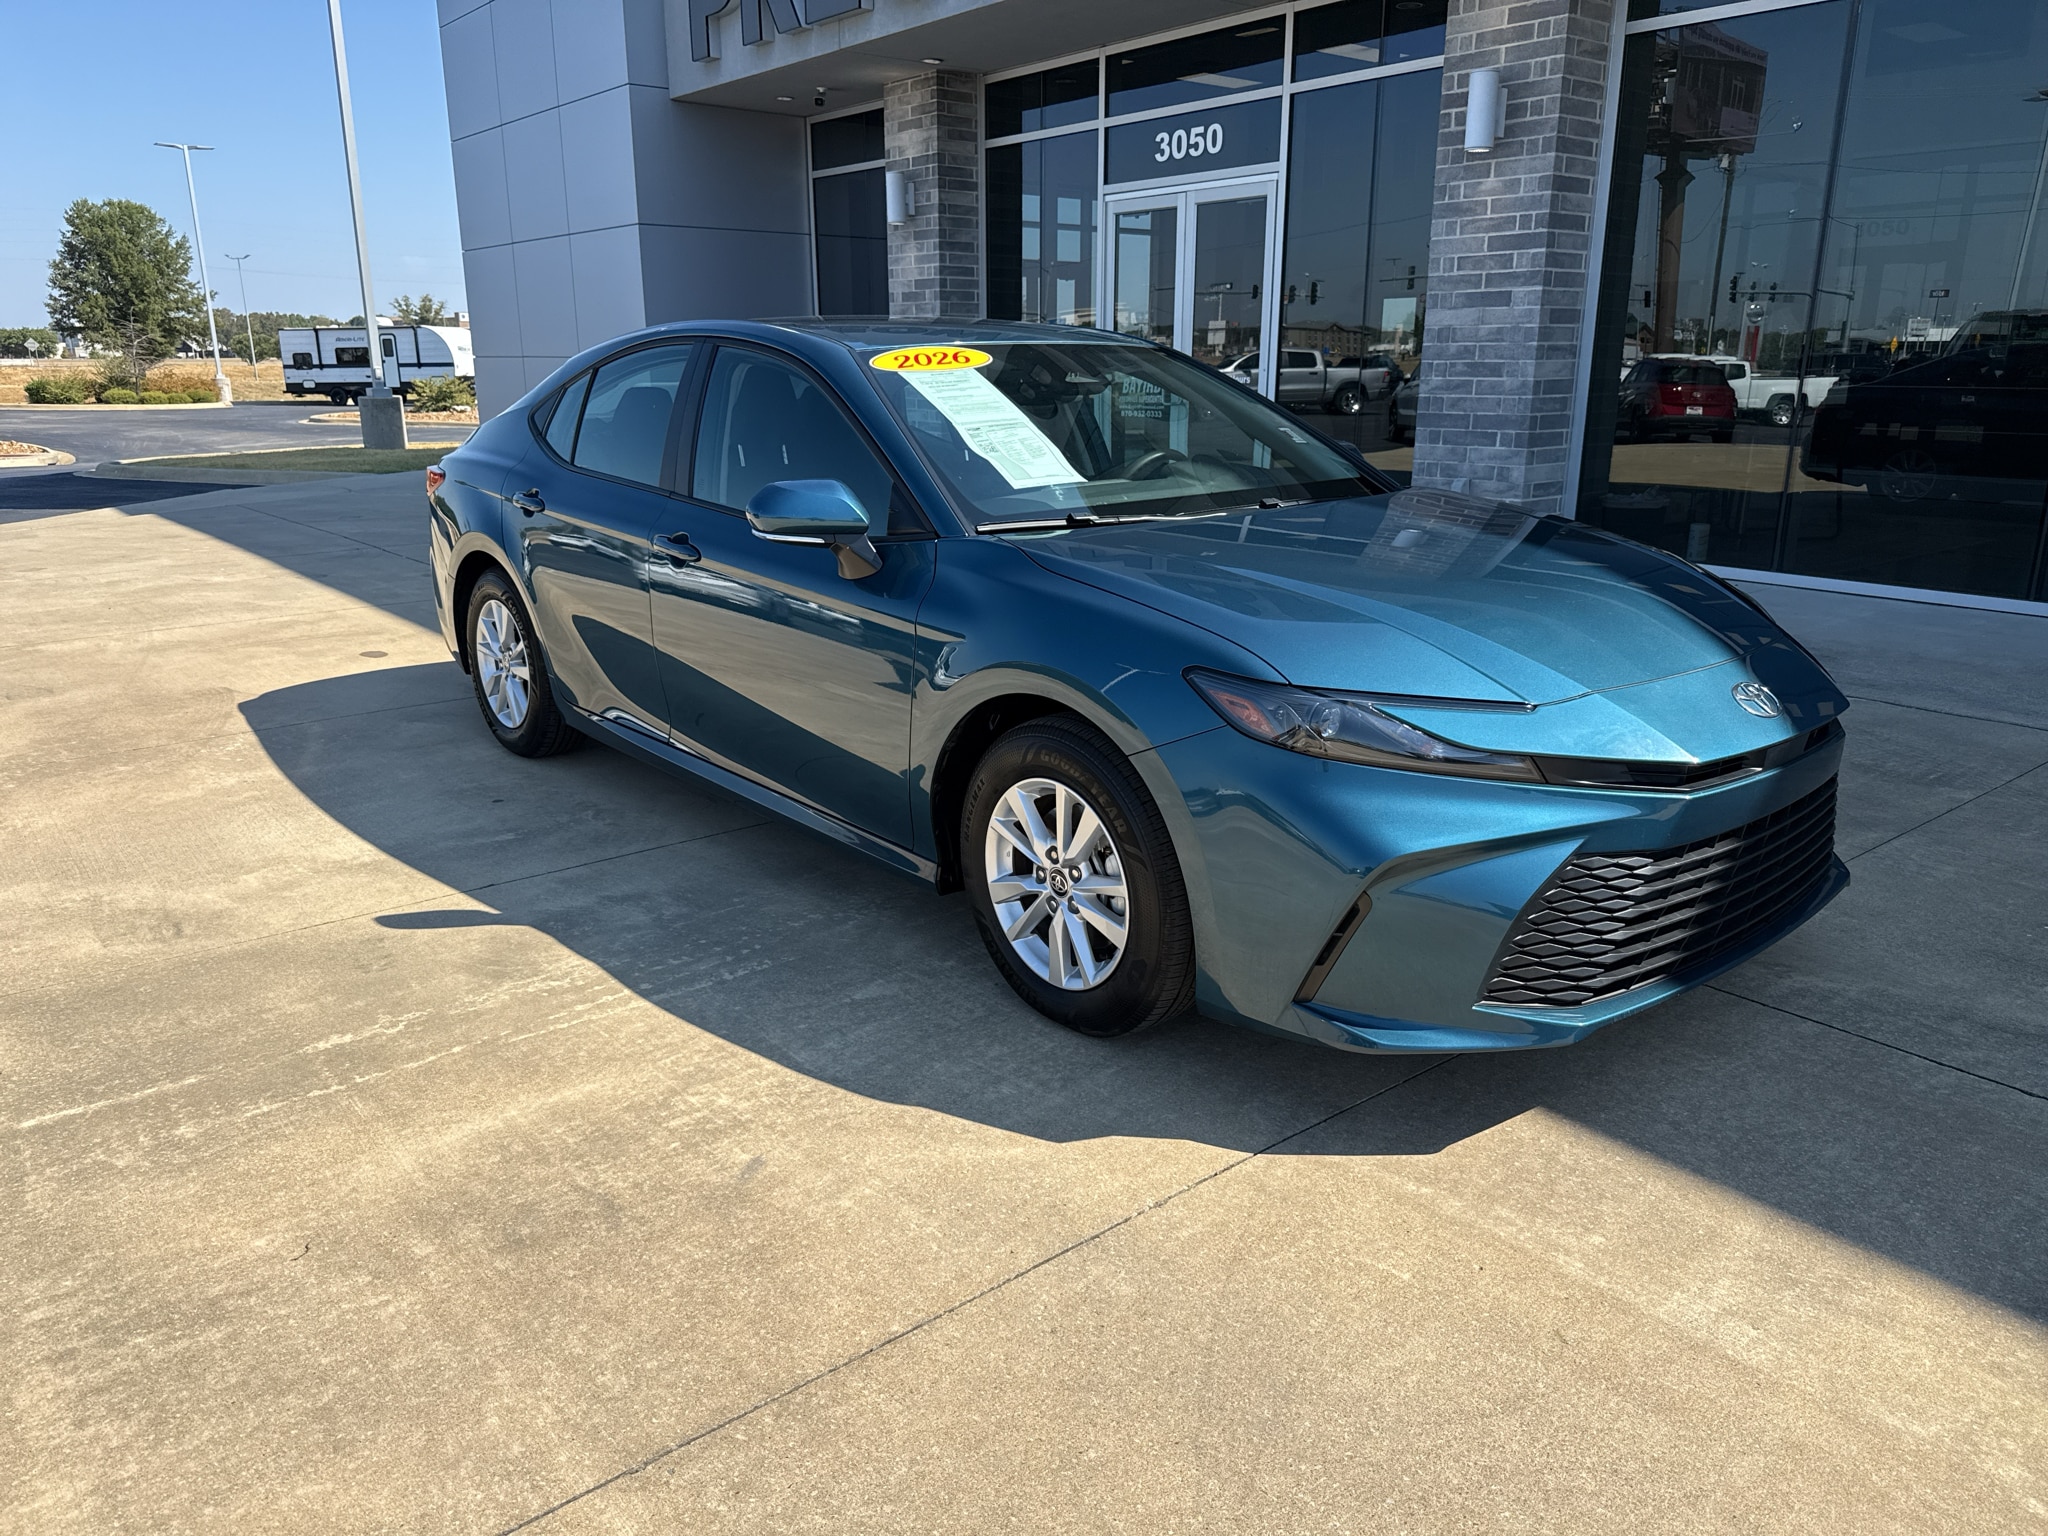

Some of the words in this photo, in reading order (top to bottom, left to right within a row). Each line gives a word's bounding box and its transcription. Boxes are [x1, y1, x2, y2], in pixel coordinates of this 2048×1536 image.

[1155, 123, 1223, 162] 3050
[893, 351, 971, 369] 2026
[1040, 750, 1127, 834] GOODYEAR
